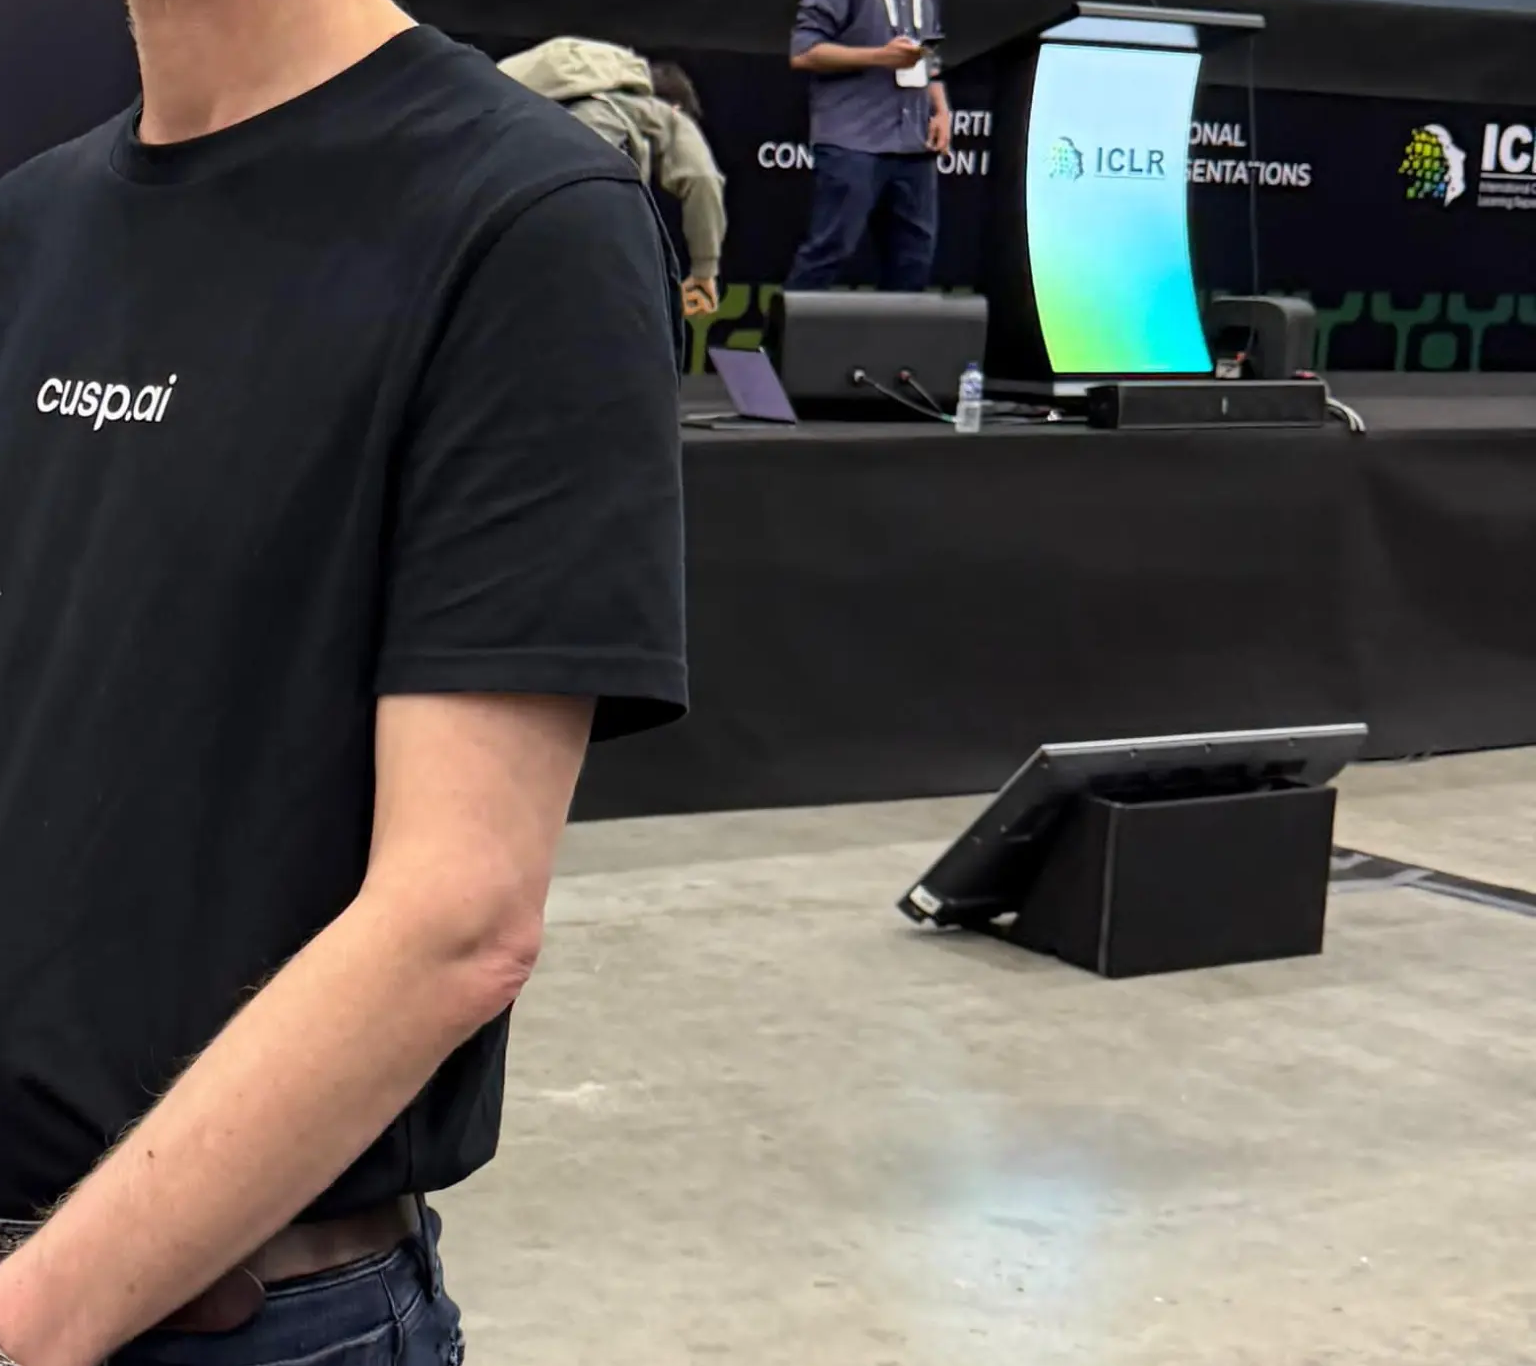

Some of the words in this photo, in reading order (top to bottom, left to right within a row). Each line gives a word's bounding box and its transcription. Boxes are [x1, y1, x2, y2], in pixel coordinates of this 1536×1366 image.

[1097, 147, 1164, 175] ICLR
[1481, 122, 1536, 174] IC
[1186, 157, 1312, 187] ENTATIONS
[36, 373, 178, 431] cusp.ai
